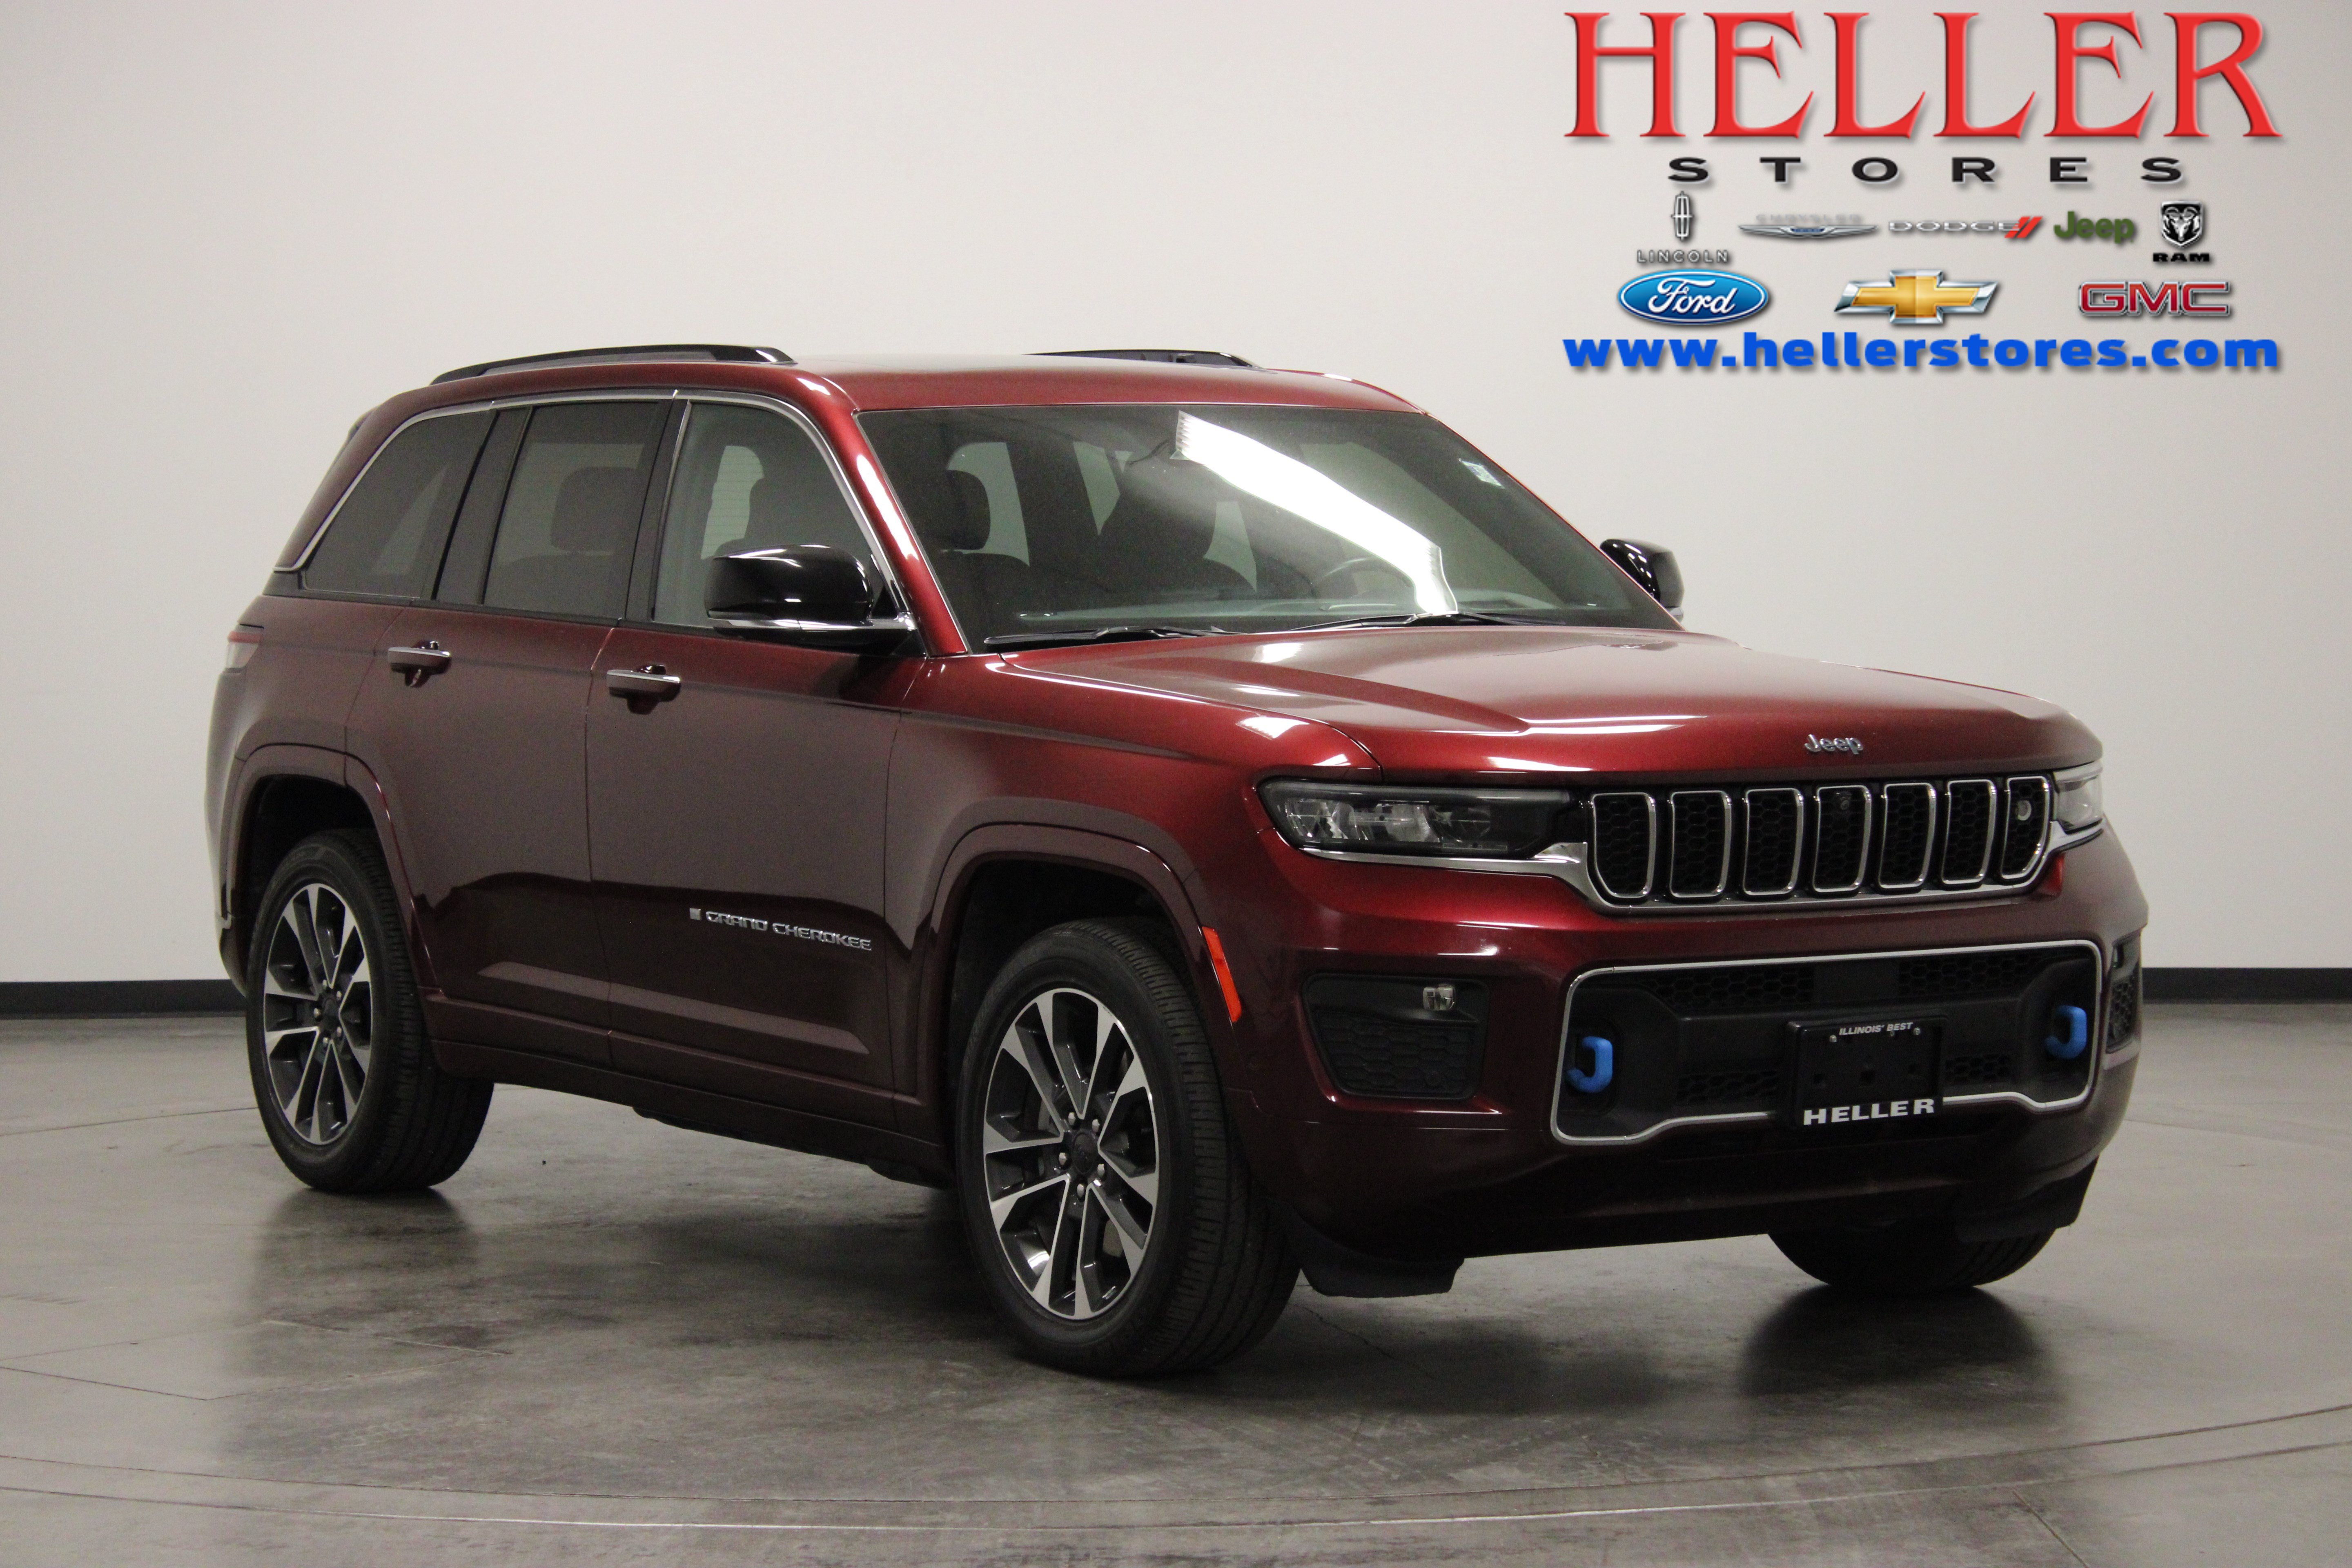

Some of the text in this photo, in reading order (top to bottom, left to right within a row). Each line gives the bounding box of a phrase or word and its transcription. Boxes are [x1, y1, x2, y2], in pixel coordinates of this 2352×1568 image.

[1804, 734, 1864, 755] Jeep
[706, 911, 872, 951] GRAND CHEROKEE
[1839, 1022, 1914, 1036] ILLINOIS' BEST
[1803, 1098, 1935, 1125] HELLER
